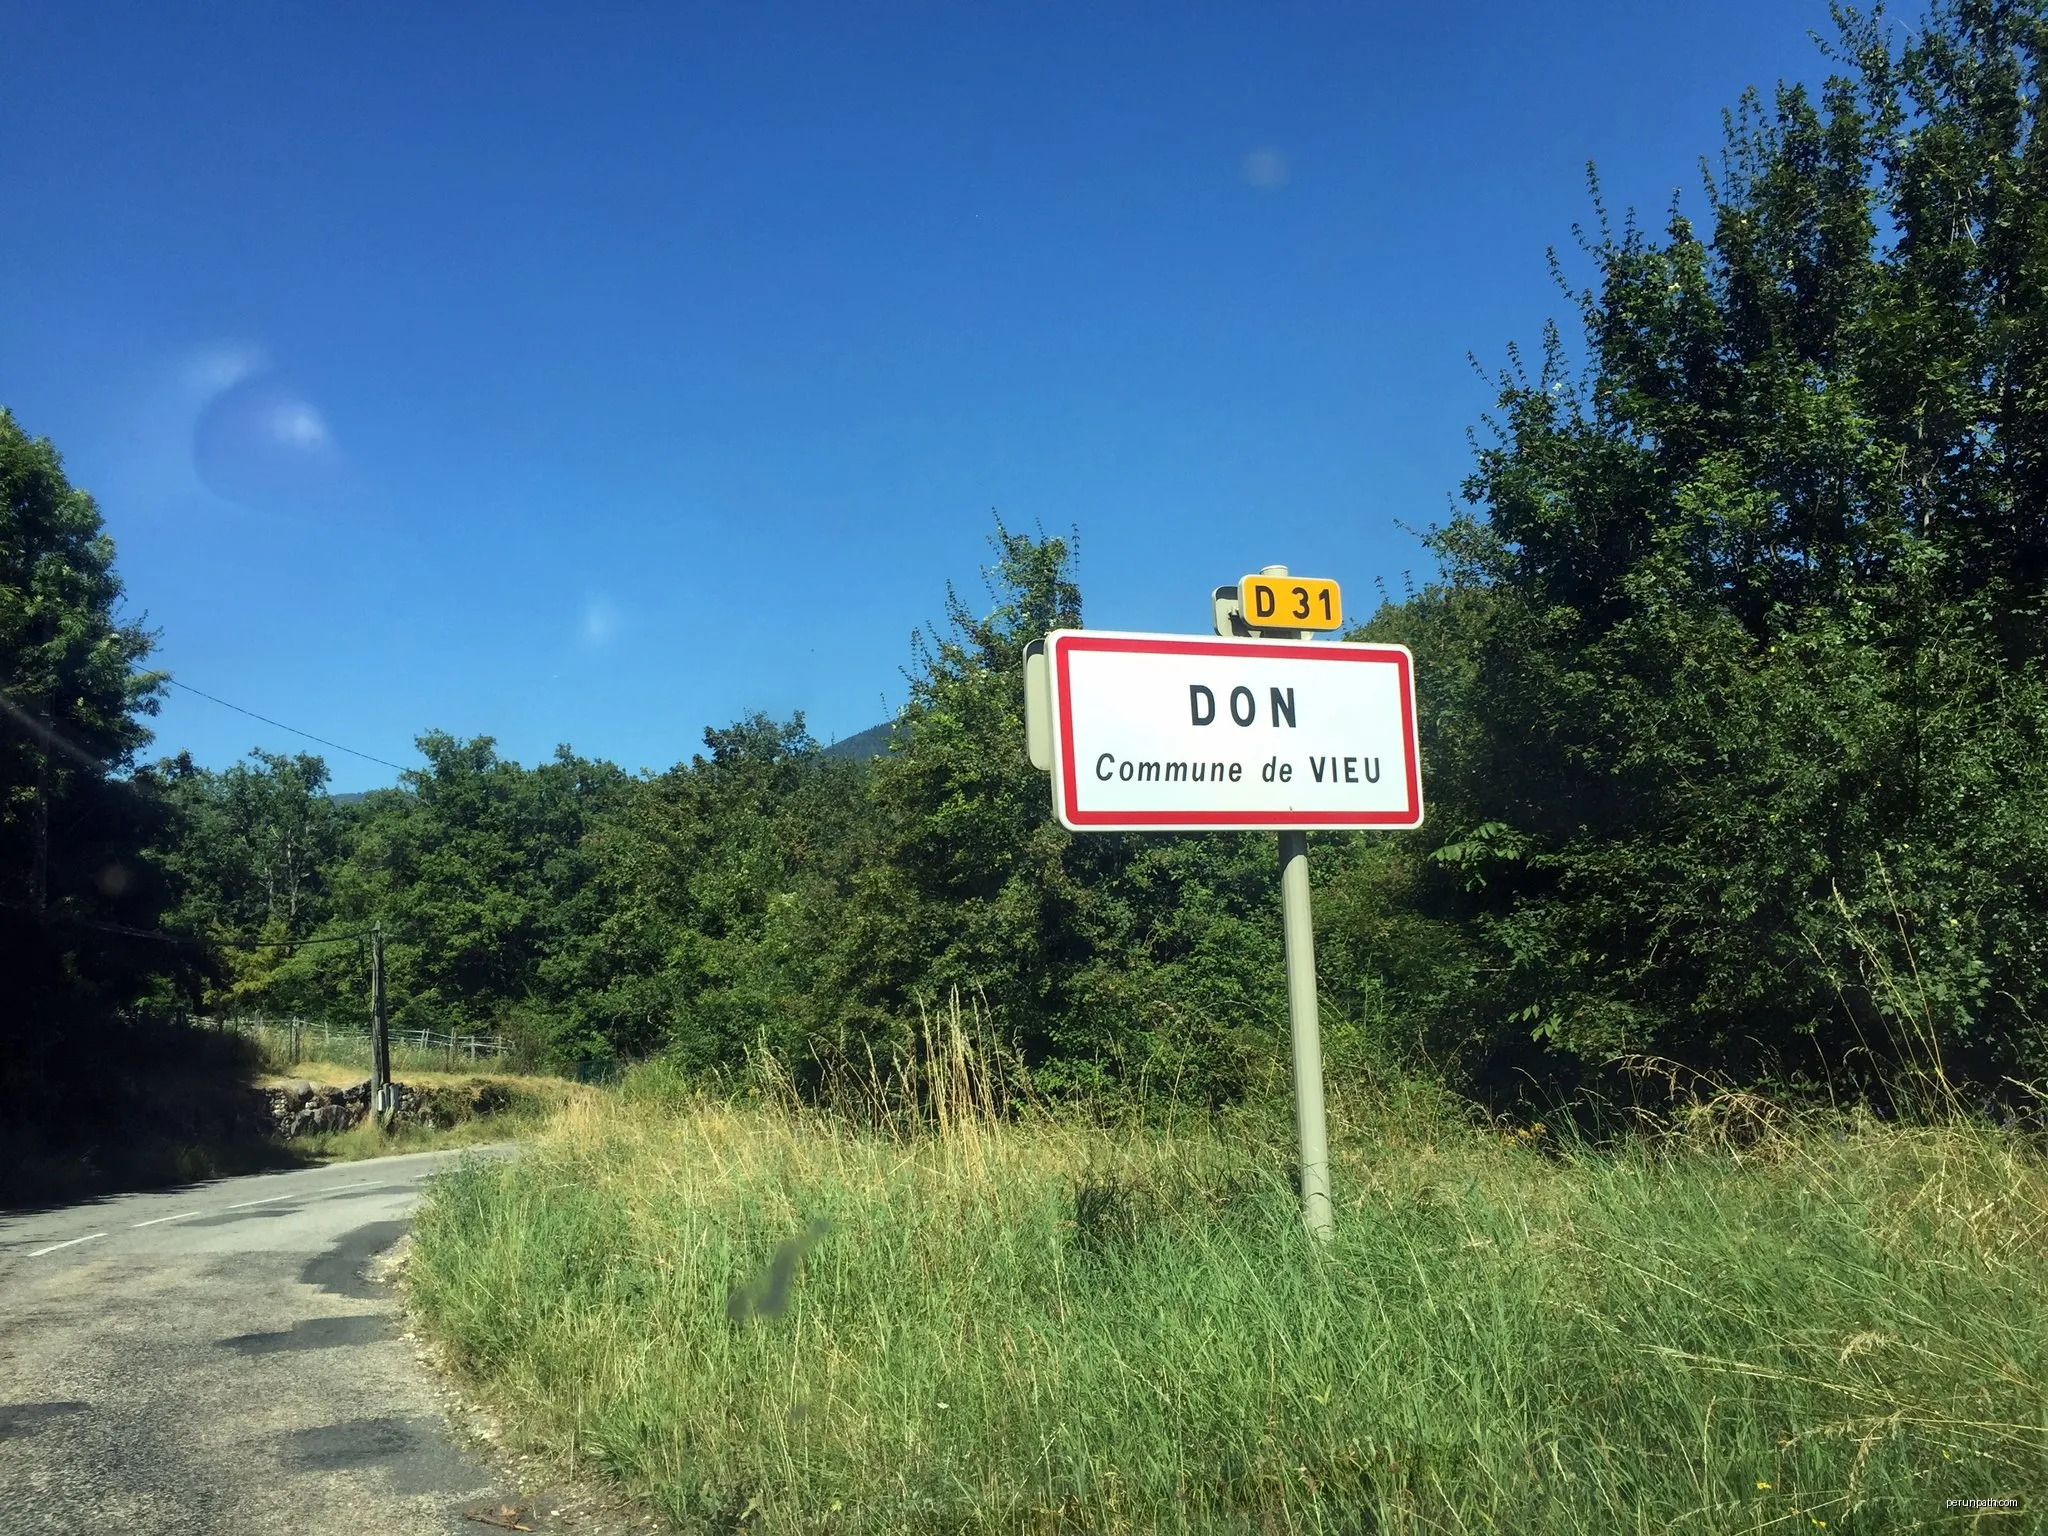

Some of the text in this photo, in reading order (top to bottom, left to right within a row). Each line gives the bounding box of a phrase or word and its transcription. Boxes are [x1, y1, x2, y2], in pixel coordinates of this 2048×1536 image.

[1255, 585, 1331, 621] D 31
[1189, 684, 1297, 728] DON
[1095, 752, 1381, 784] Commune de VIEU
